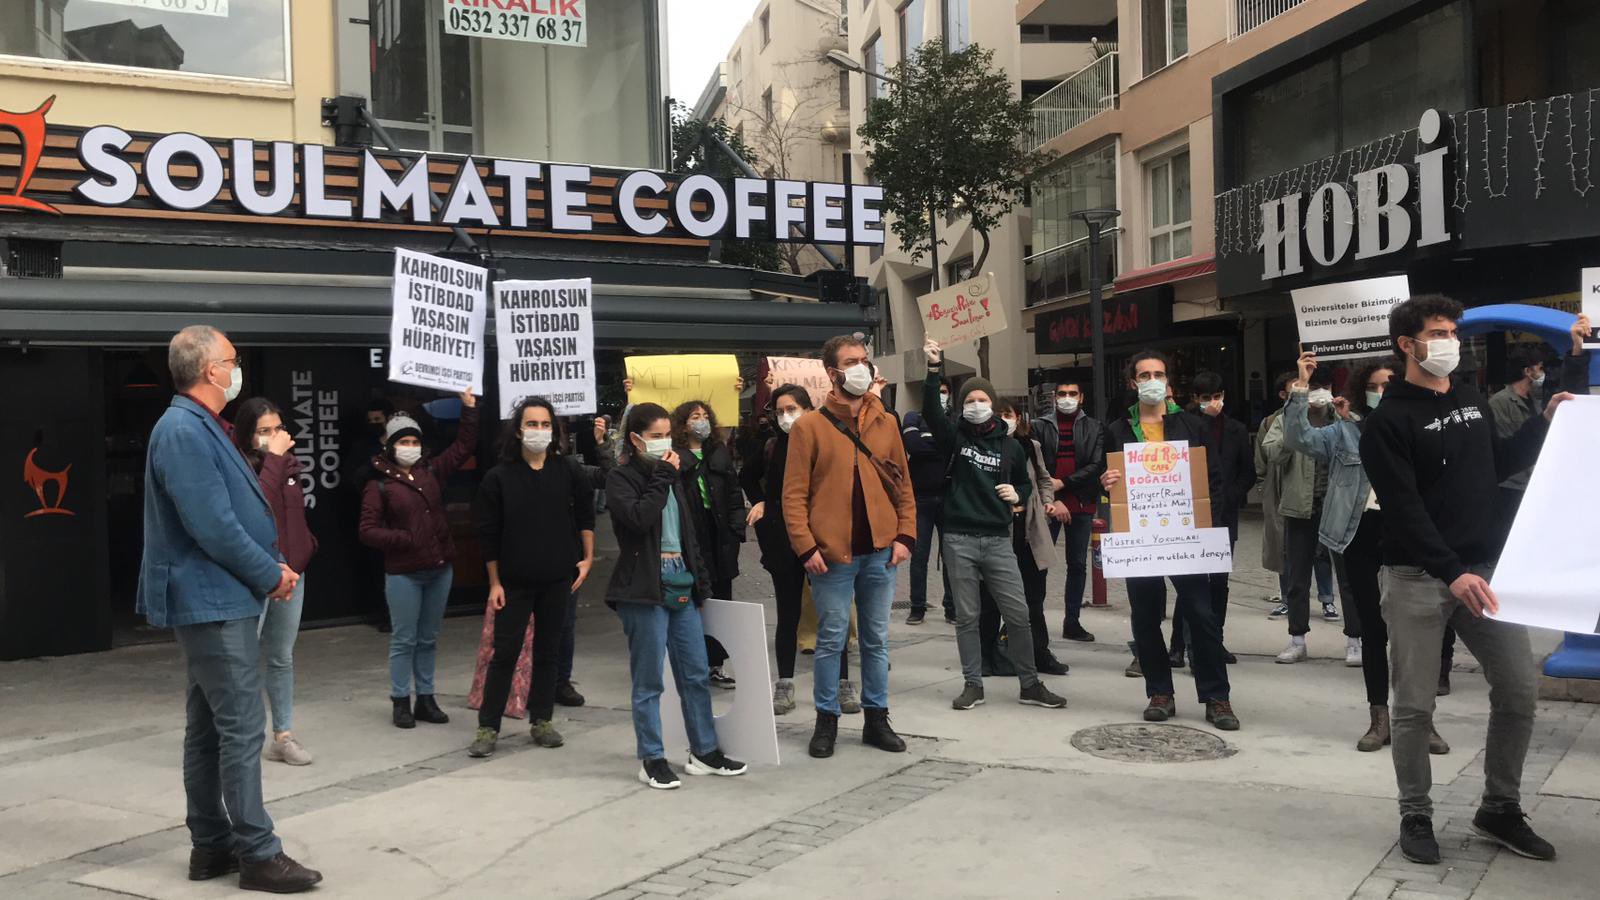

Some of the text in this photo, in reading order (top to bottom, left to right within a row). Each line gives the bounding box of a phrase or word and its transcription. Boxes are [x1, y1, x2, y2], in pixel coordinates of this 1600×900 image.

[446, 0, 582, 18] ALIK
[449, 7, 582, 43] 0532 337 68 37
[77, 125, 884, 244] SOULMATE COFFEE
[400, 255, 483, 291] KAHROLSUN
[408, 278, 474, 312] İSTİBDAD
[500, 288, 587, 309] KAHROLSUN
[1301, 302, 1358, 313] Üniversiteler
[411, 305, 469, 335] YAŞASIN
[510, 311, 579, 333] İSTİBDAD
[1305, 318, 1337, 328] Bizimle
[402, 326, 476, 359] HÜRRİYET!
[515, 337, 577, 360] YAŞASIN
[1312, 342, 1354, 353] Üniversite
[509, 359, 585, 382] HÜRRİYET!
[292, 370, 316, 510] SOULMATE
[318, 390, 340, 489] COFFEE
[1127, 447, 1188, 463] Hard Rock
[1157, 551, 1195, 560] mutlaka
